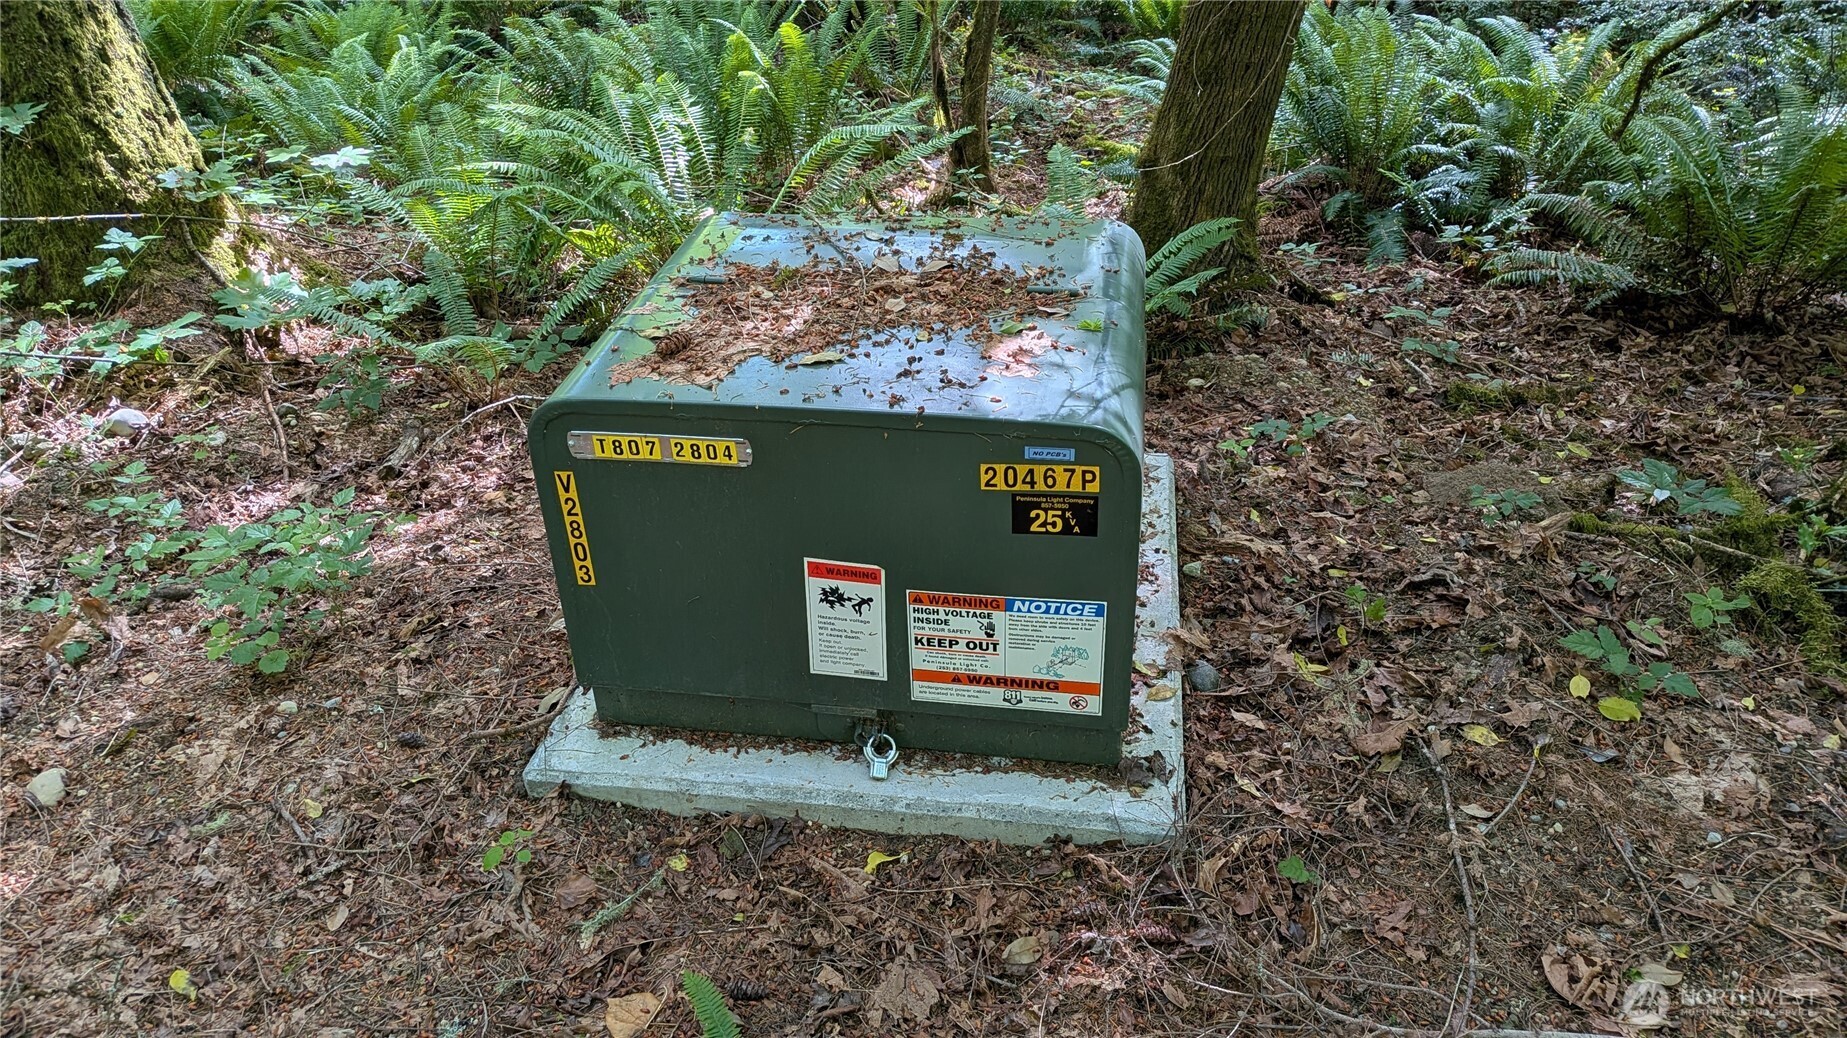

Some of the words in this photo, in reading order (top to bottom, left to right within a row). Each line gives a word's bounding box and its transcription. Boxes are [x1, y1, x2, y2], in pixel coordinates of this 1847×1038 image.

[596, 438, 656, 456] T807
[674, 442, 734, 461] 2804
[984, 466, 1097, 490] 20467P
[556, 473, 592, 584] V2803
[1030, 510, 1063, 533] 25
[825, 567, 878, 580] WARNING
[927, 594, 1000, 609] WARNING
[1013, 600, 1098, 616] NOTICE
[913, 607, 940, 616] HIGH
[944, 609, 994, 620] VOLTAGE
[913, 617, 950, 626] INSIDE
[914, 636, 960, 648] KEEP
[966, 640, 1000, 652] OUT
[966, 675, 1059, 690] WARNING
[1004, 690, 1021, 700] 811
